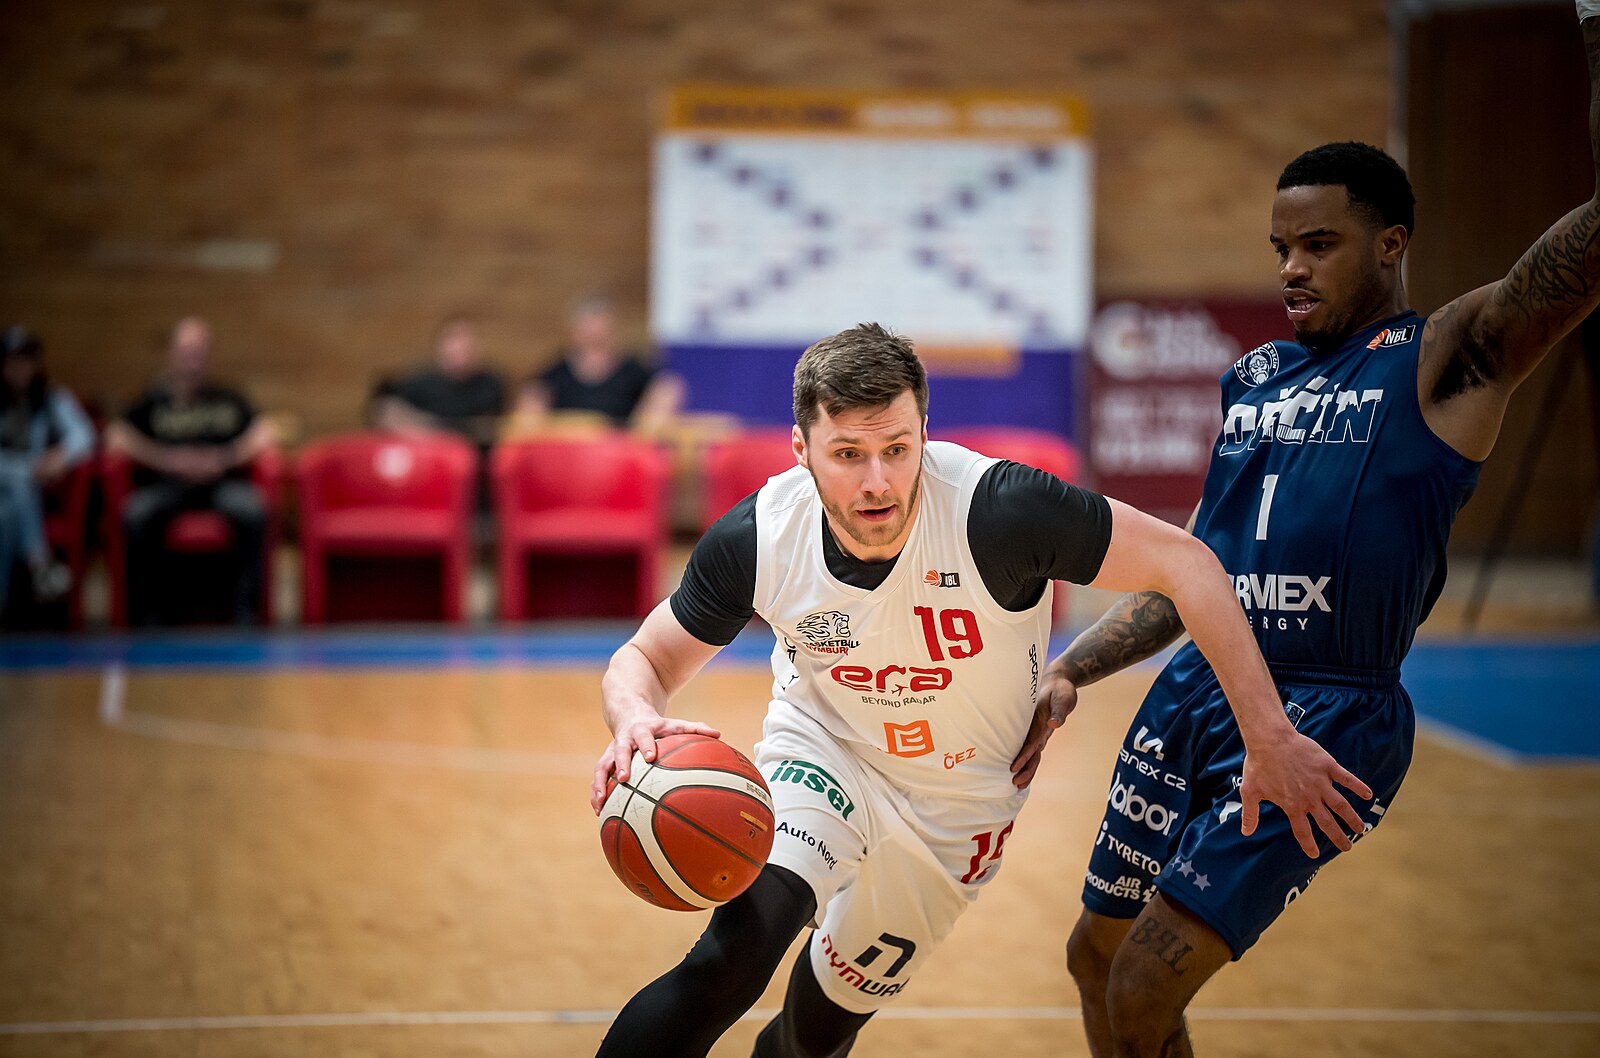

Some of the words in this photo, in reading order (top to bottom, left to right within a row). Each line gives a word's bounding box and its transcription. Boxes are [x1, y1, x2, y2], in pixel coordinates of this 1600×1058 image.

[1385, 328, 1407, 344] NBL
[1255, 473, 1279, 540] 1
[1227, 573, 1332, 612] RMEX
[914, 605, 983, 662] 19
[831, 664, 952, 692] era
[861, 695, 901, 708] BEYOND
[903, 695, 936, 706] RADAR
[943, 747, 977, 770] ČEZ
[1119, 746, 1160, 780] anex
[770, 760, 855, 821] insel
[776, 821, 816, 847] Auto
[817, 842, 838, 871] Nord
[1115, 875, 1142, 889] AIR
